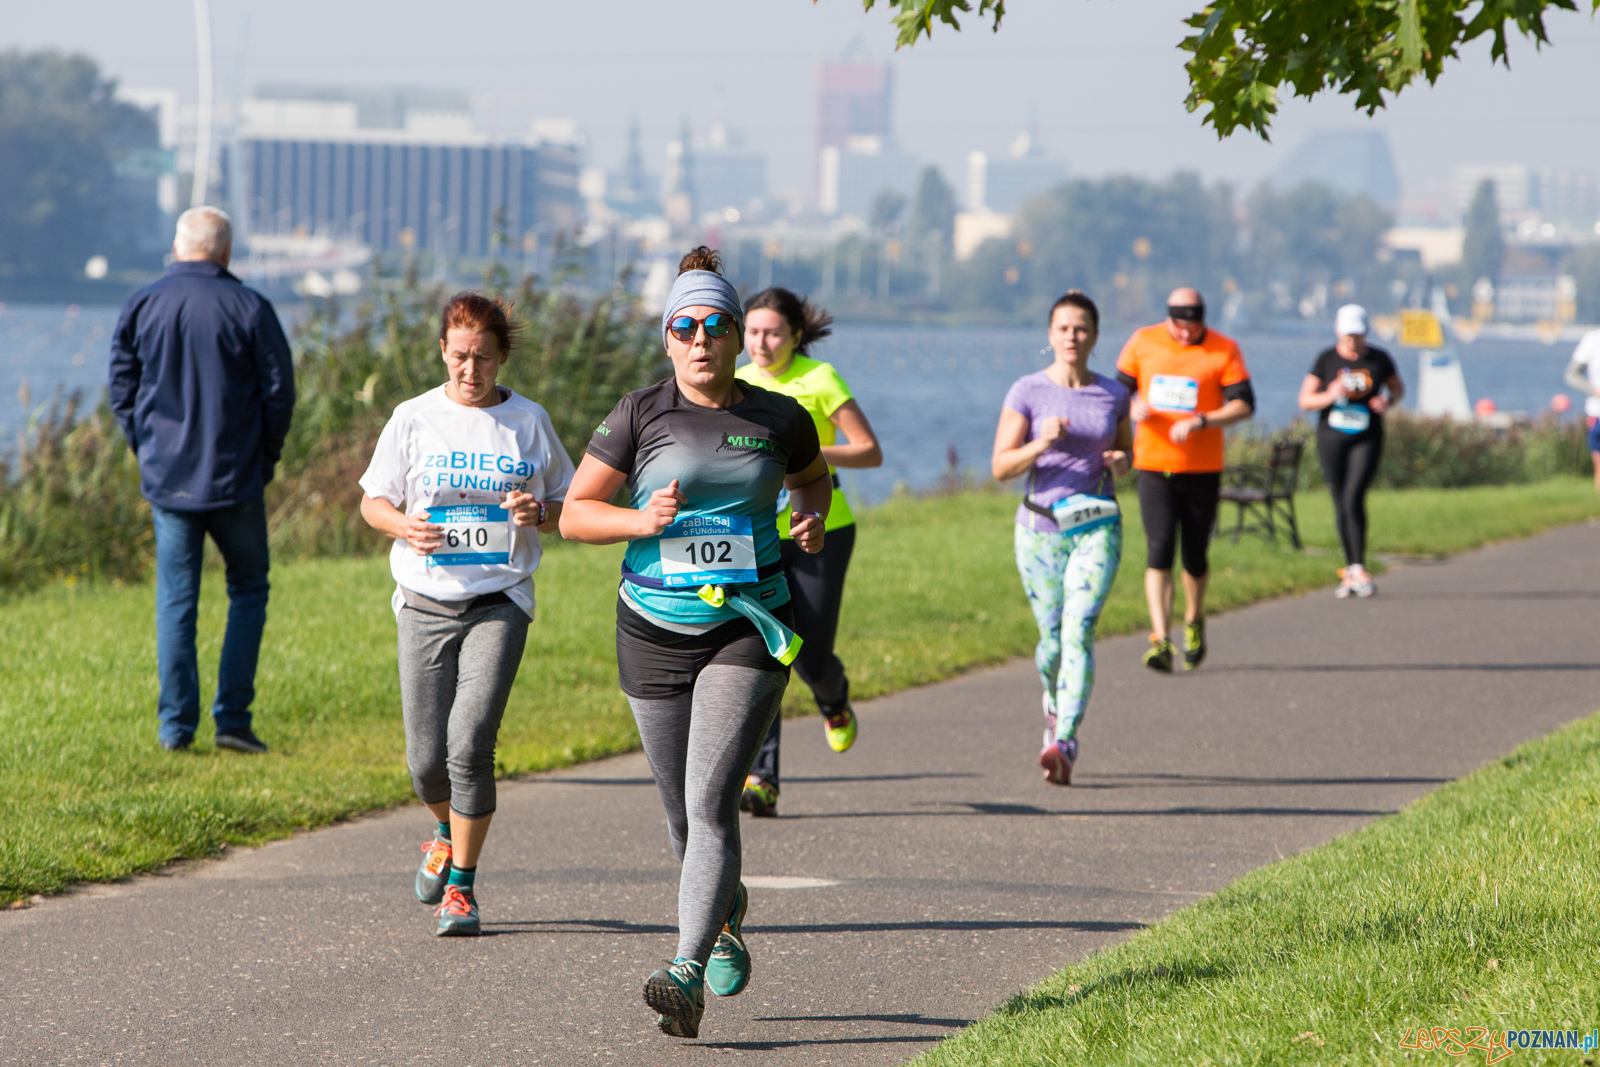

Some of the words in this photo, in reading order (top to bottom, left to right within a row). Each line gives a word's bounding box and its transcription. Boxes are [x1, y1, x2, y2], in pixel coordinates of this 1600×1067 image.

[727, 435, 777, 453] MUAY
[424, 451, 535, 481] zaBIEGaj
[422, 475, 431, 486] o
[437, 472, 527, 493] FUNdusze
[445, 506, 487, 517] zaBIEGaj
[452, 515, 487, 523] FUNdusze
[1074, 506, 1102, 523] 214
[682, 516, 730, 528] zaBIEGaj
[446, 527, 488, 548] 610
[690, 526, 731, 536] FUNdusze
[685, 540, 733, 565] 102
